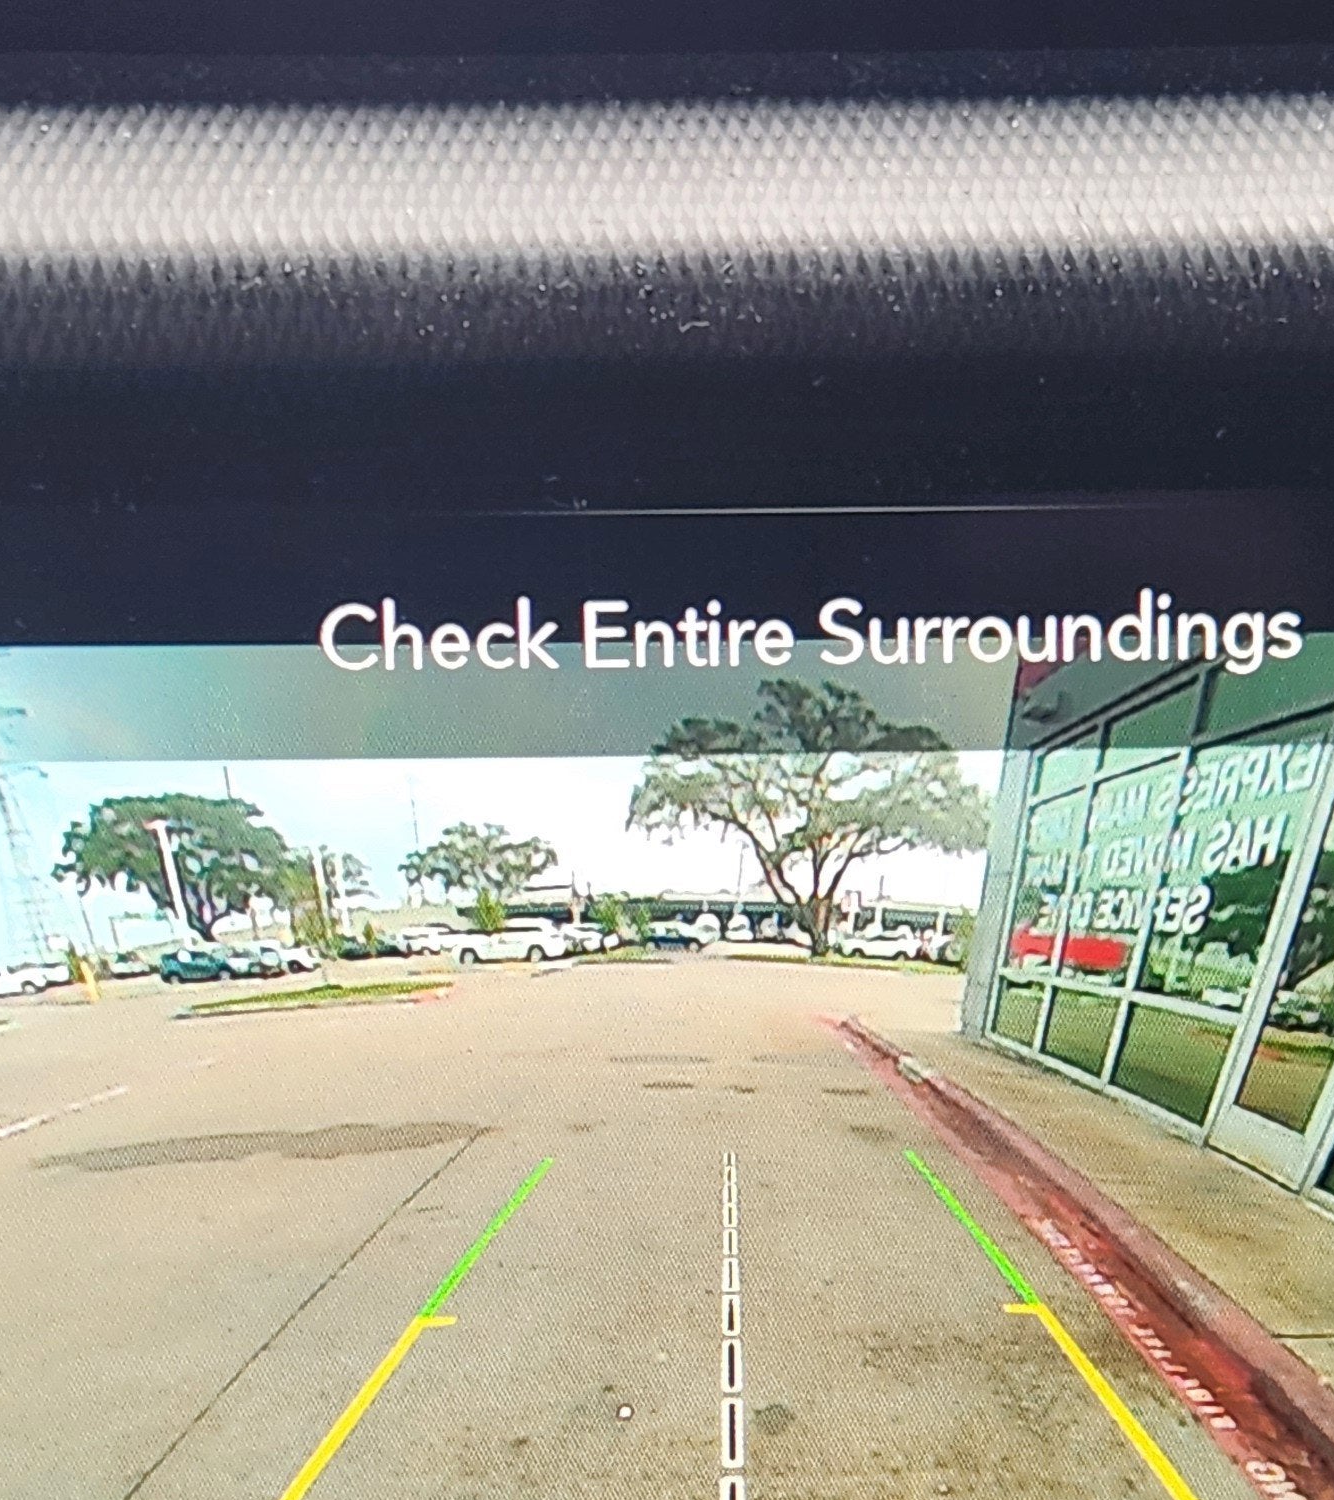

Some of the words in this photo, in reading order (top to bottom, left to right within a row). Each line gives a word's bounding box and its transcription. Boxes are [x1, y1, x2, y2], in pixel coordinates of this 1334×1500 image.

[318, 597, 560, 671] Check
[582, 597, 795, 669] Entire
[817, 587, 1304, 676] Surroundings
